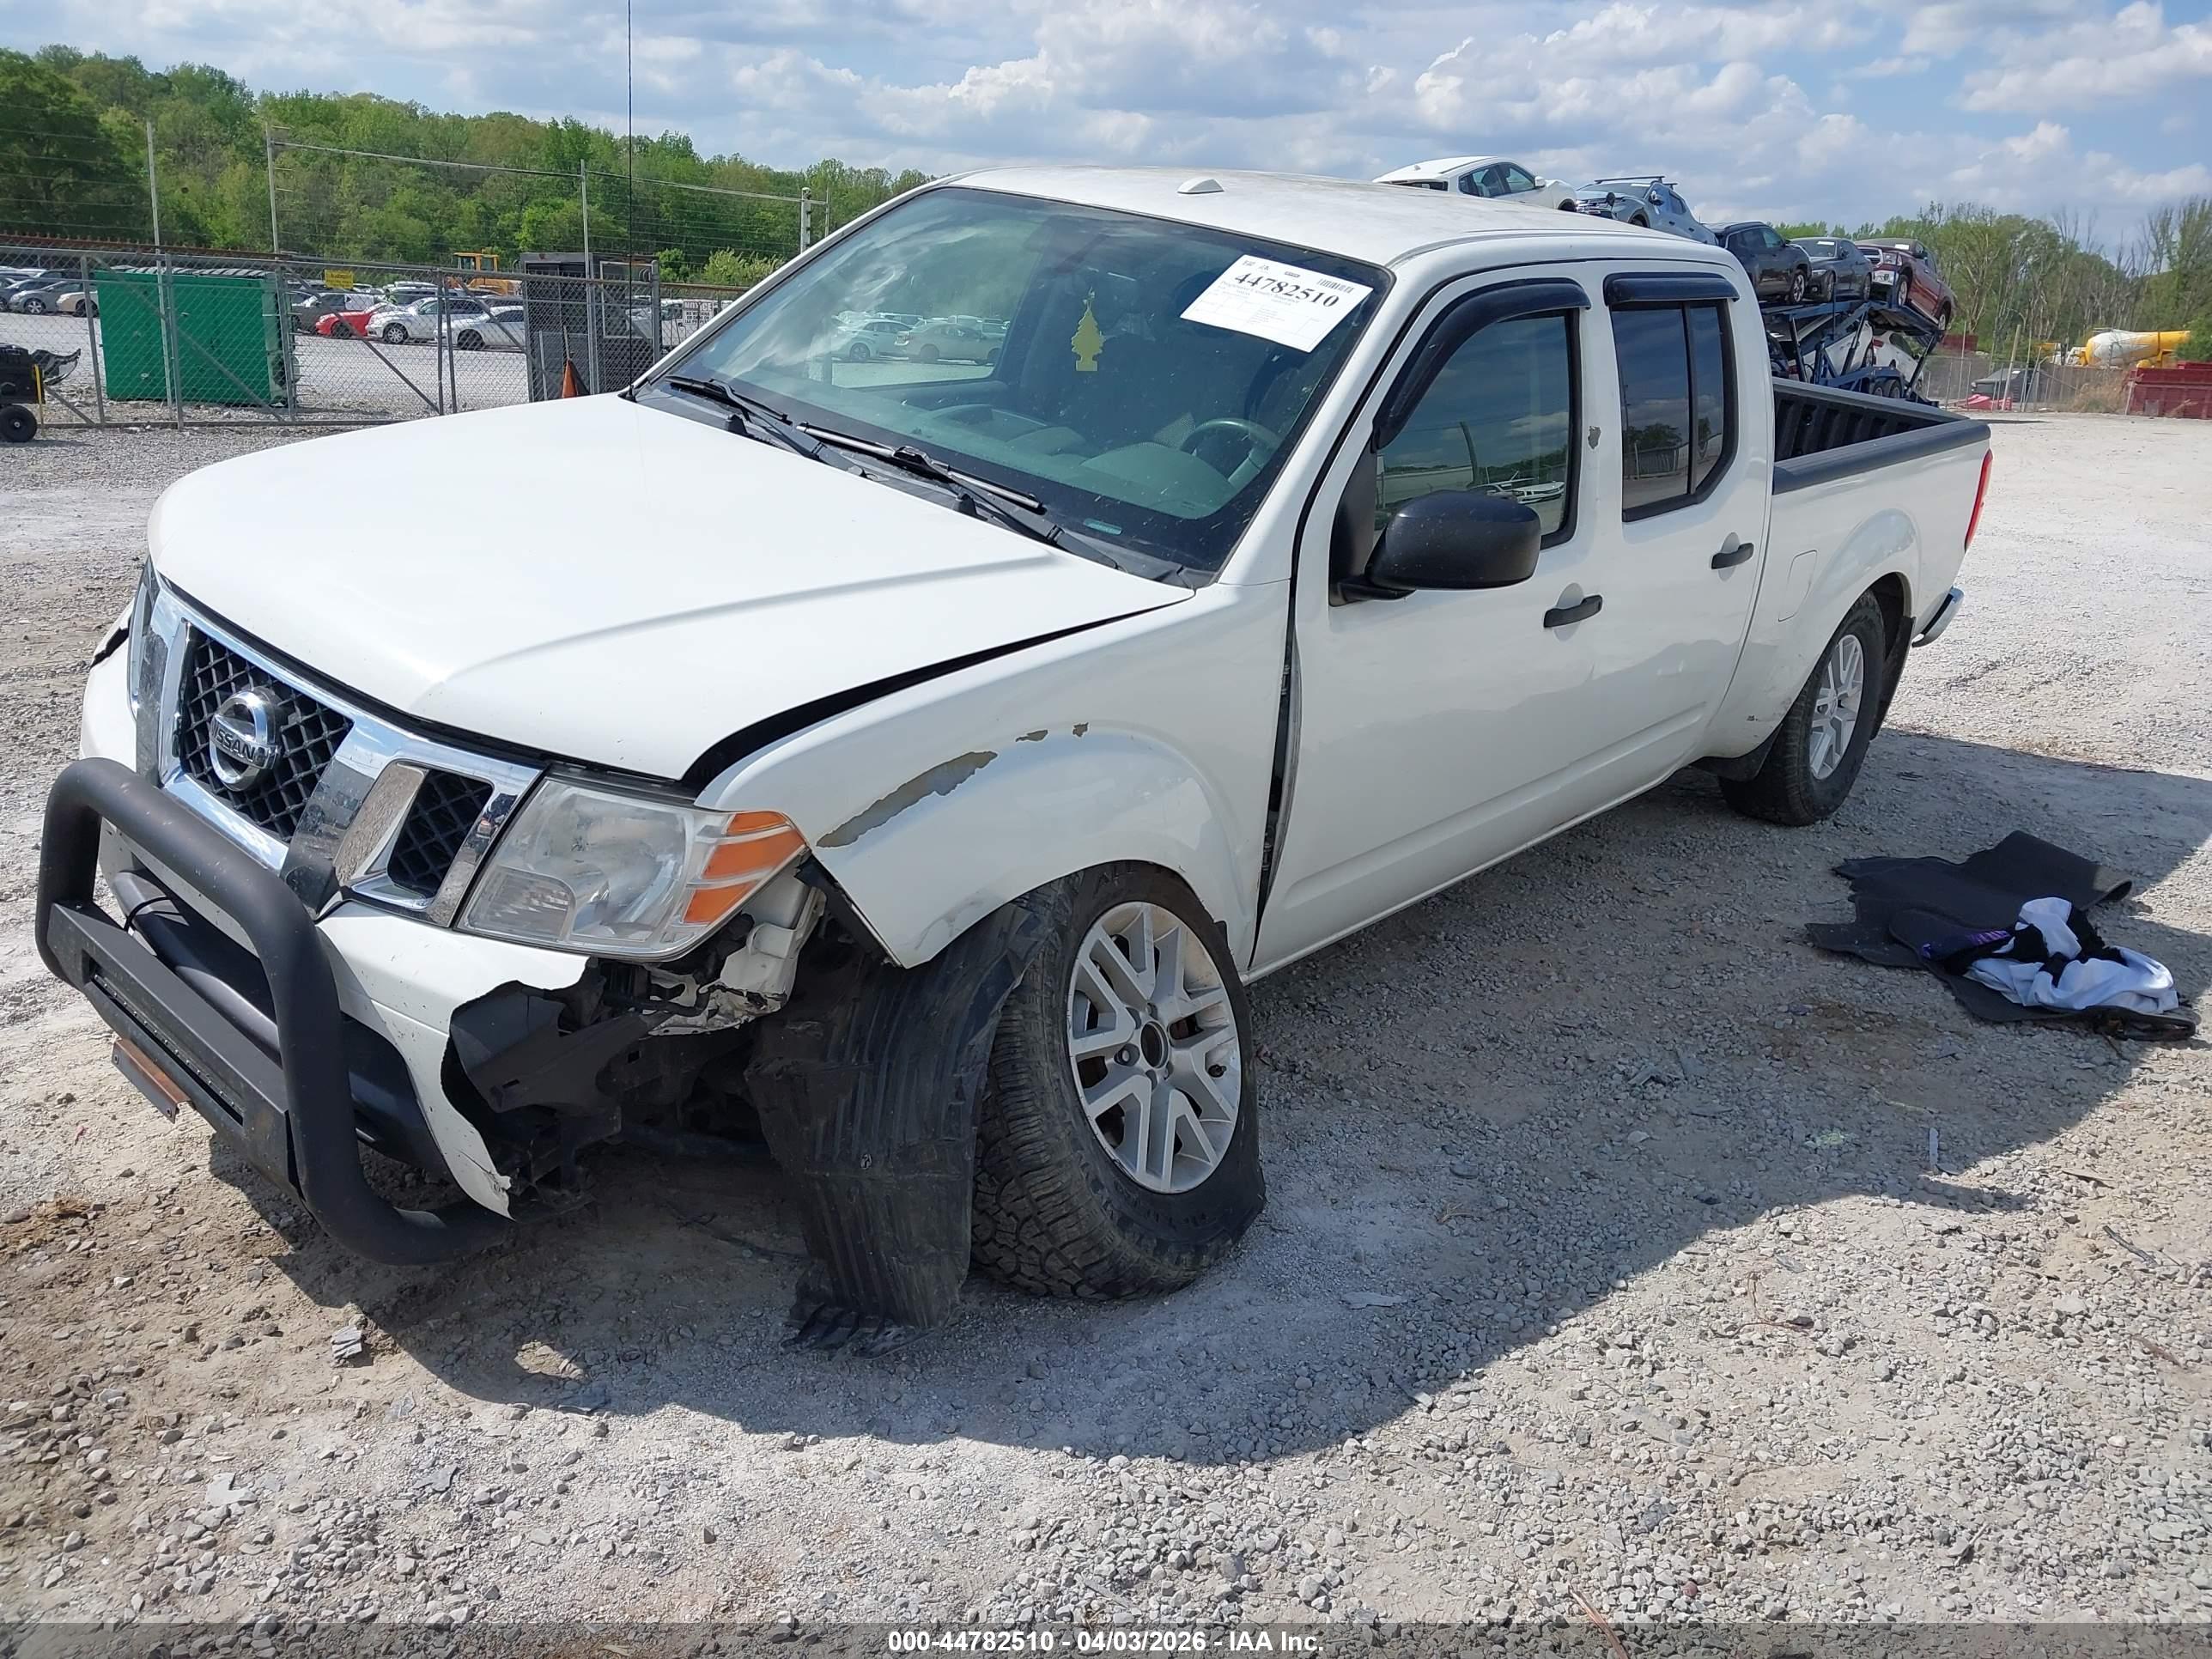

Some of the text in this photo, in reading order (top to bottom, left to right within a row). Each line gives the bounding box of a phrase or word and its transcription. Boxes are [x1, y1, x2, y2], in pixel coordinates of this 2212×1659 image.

[684, 301, 712, 311] NOTICE
[1235, 273, 1340, 307] 44782510
[210, 720, 255, 762] NISSAN
